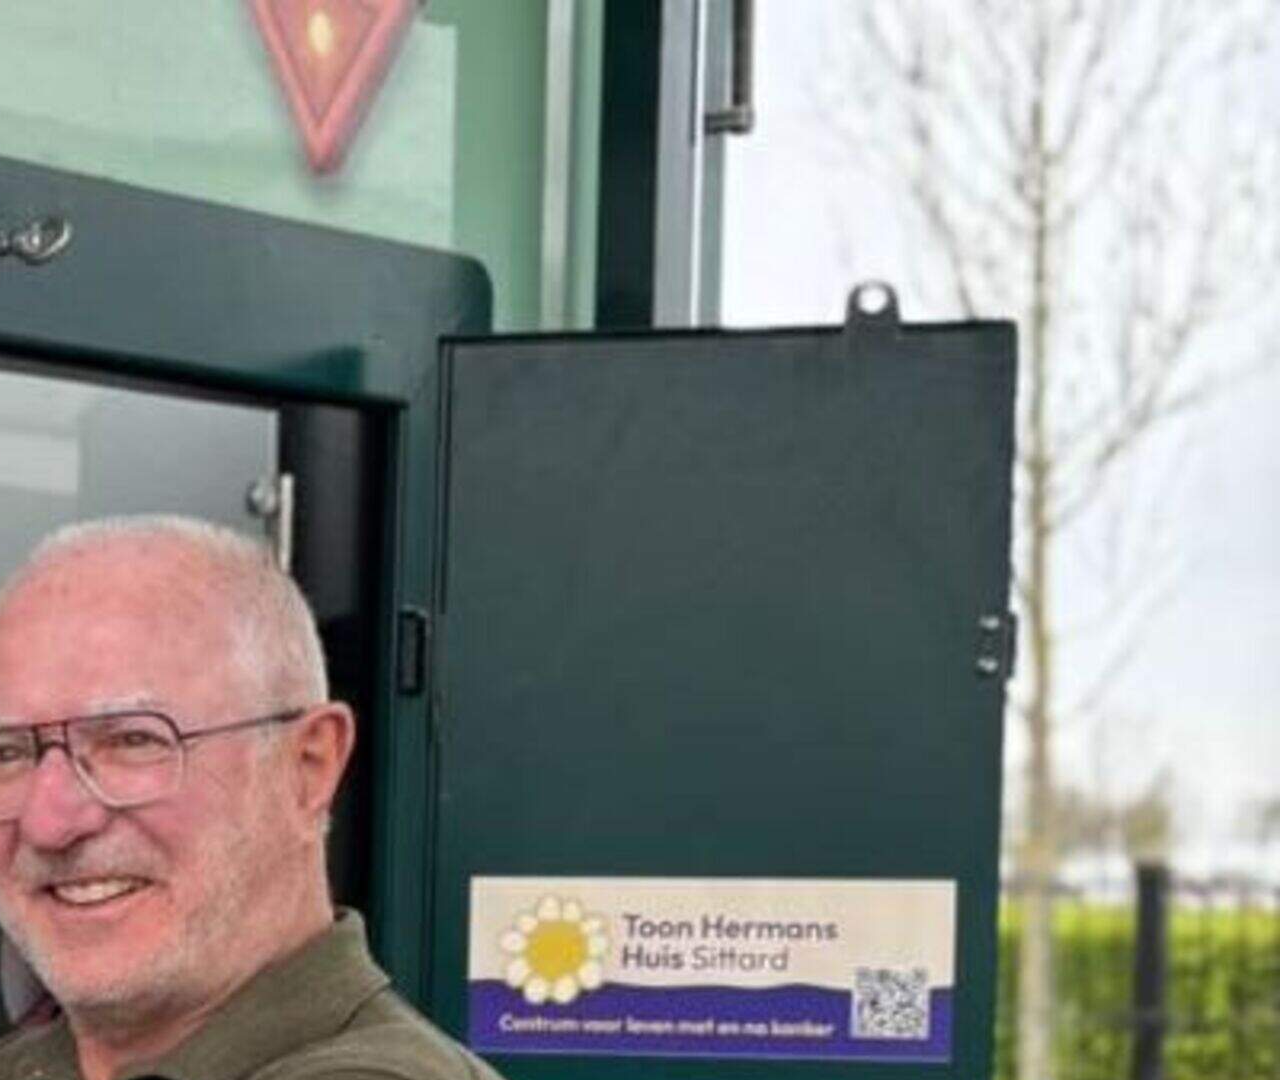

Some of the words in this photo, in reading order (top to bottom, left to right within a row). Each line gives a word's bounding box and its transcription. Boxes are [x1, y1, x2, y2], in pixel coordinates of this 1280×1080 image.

[621, 914, 695, 940] Toon
[700, 913, 840, 941] Hermans
[621, 945, 686, 971] Huis
[692, 944, 790, 972] Sittard
